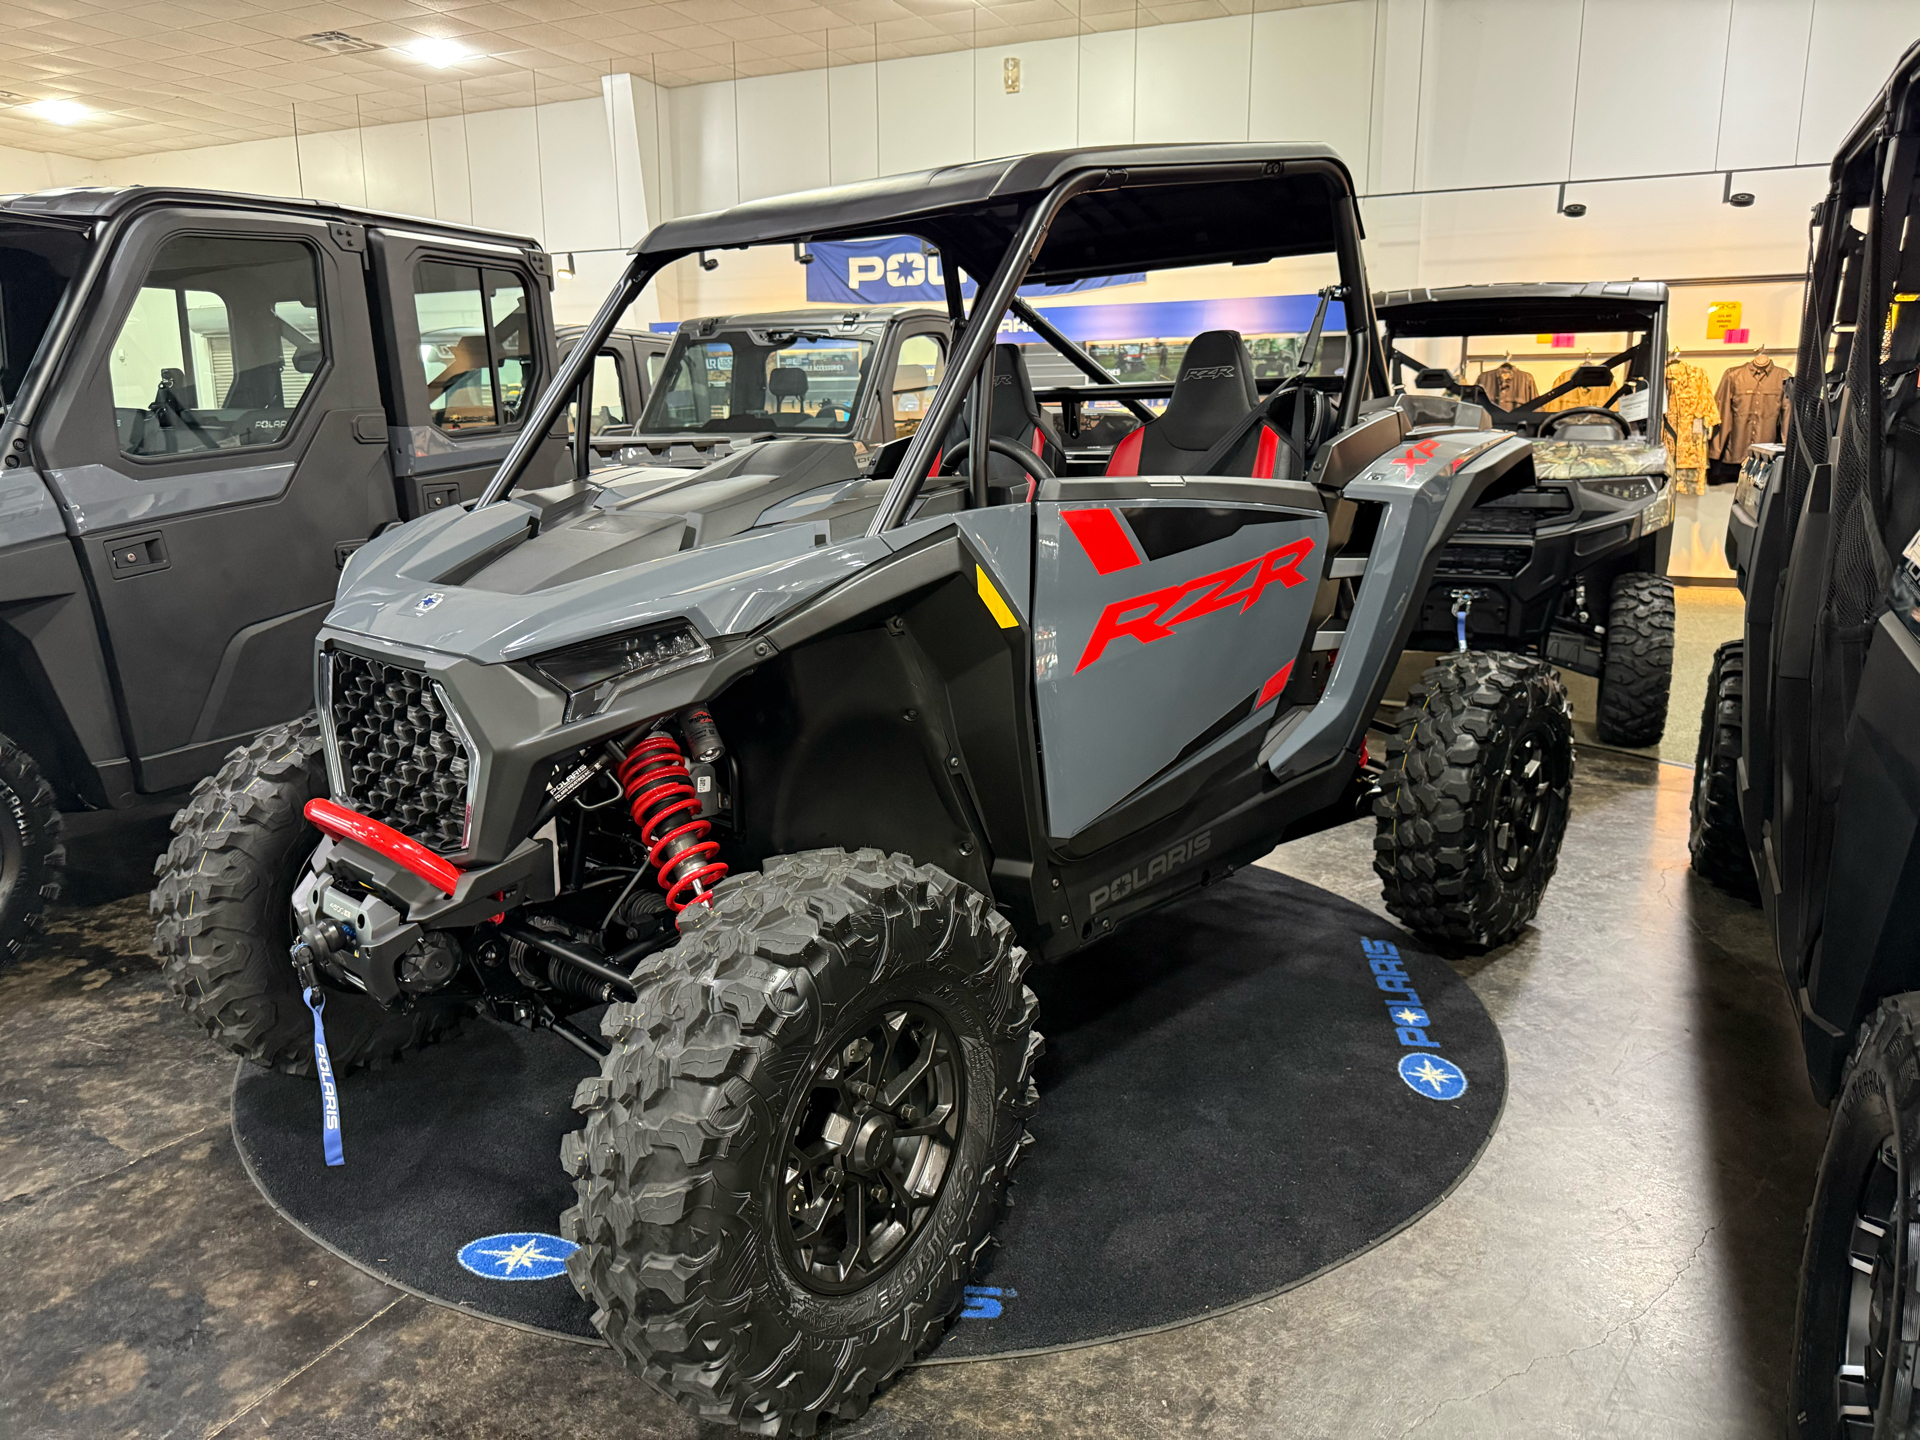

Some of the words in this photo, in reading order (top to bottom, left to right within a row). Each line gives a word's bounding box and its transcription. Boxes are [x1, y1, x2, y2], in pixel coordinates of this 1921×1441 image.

[1182, 365, 1235, 382] RZR
[255, 420, 287, 429] POLAR
[1390, 438, 1442, 482] XP
[1072, 536, 1316, 677] RZR
[549, 763, 588, 796] POLARIS
[1089, 829, 1212, 915] POLARIS
[1360, 936, 1442, 1048] POLARIS
[316, 1042, 339, 1130] POLARIS
